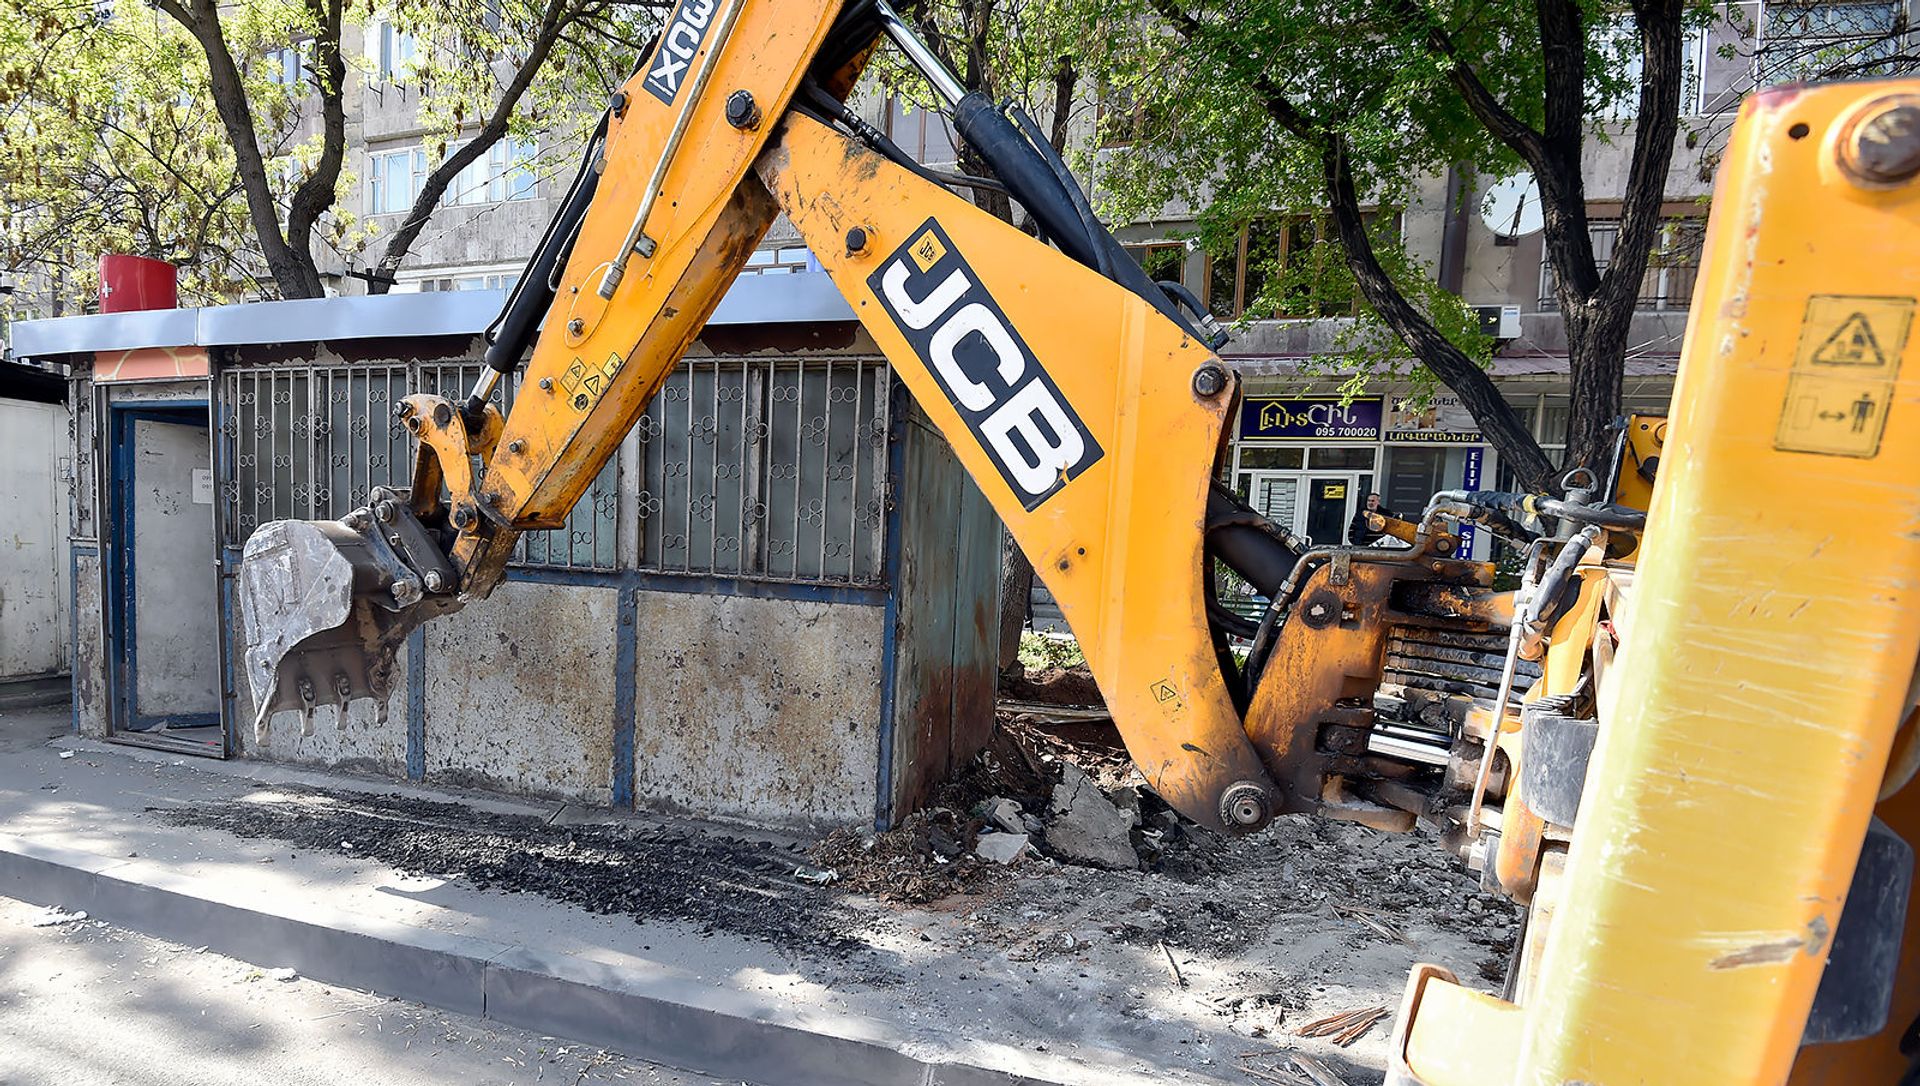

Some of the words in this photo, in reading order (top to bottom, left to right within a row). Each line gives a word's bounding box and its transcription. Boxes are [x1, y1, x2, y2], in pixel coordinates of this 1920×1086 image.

[919, 241, 936, 261] JCB
[882, 258, 1084, 495] JCB
[1315, 427, 1336, 437] 095
[1339, 427, 1377, 437] 700020
[1468, 451, 1479, 487] ELIT
[1459, 530, 1472, 560] SHI
